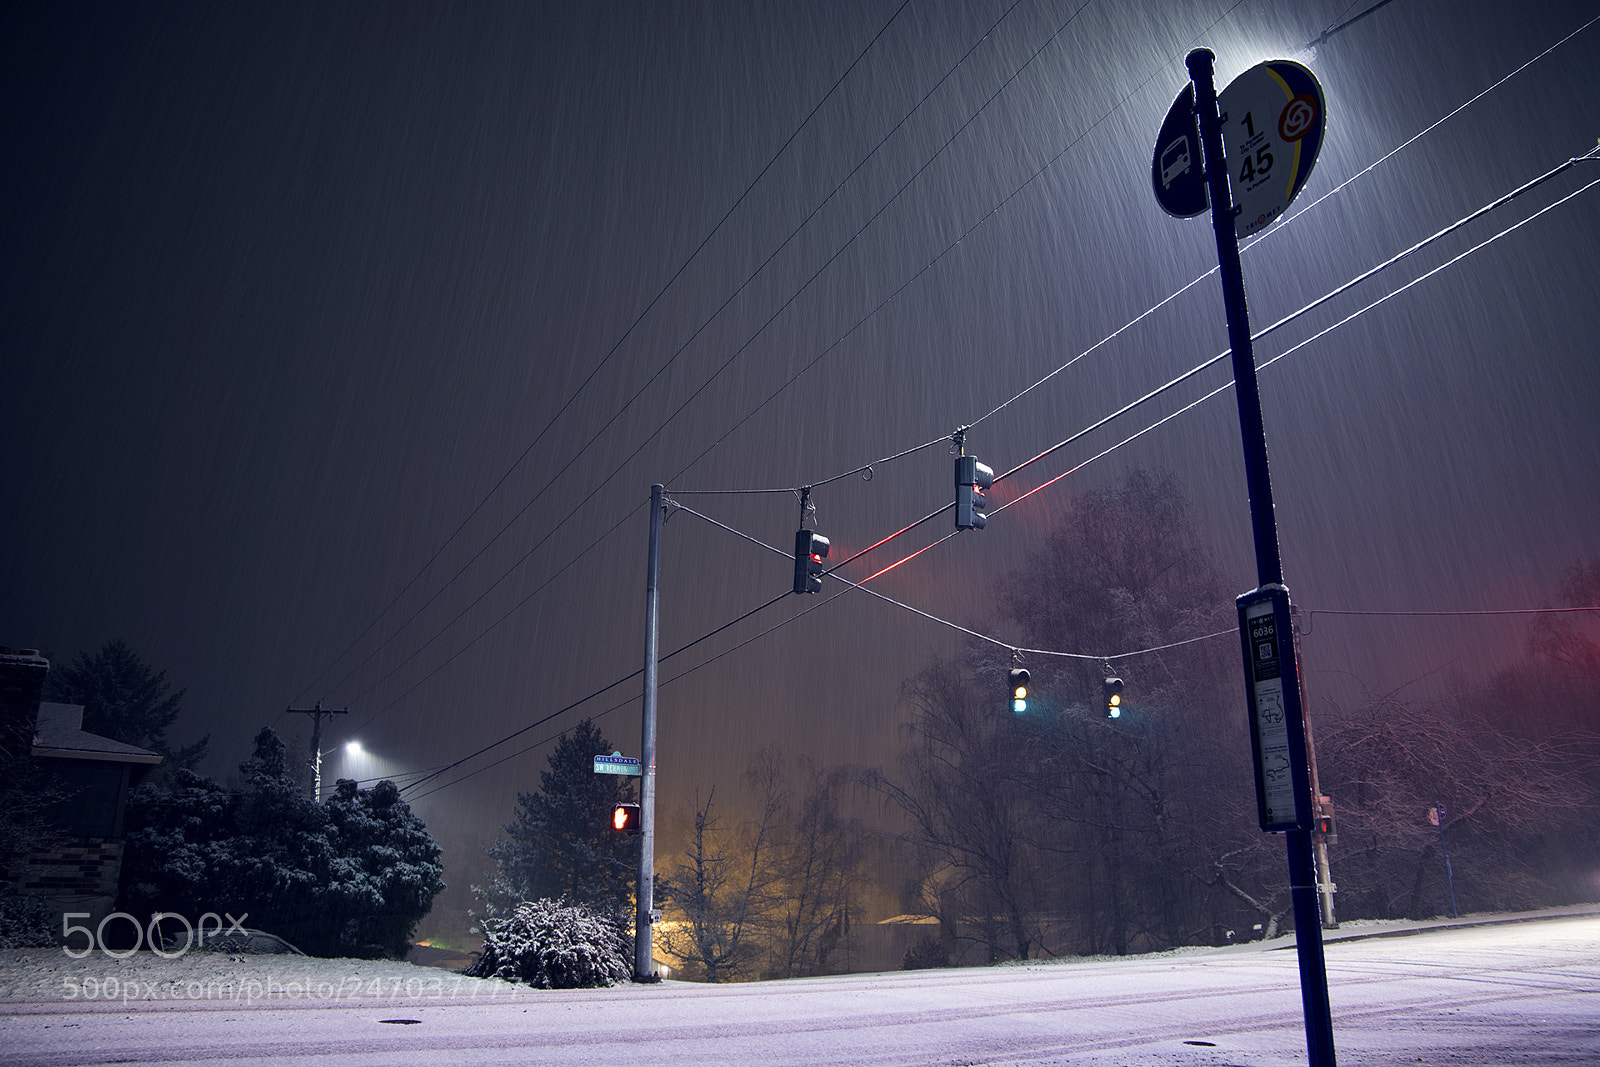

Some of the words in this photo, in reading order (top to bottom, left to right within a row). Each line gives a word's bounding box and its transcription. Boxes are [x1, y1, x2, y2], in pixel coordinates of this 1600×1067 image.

[1241, 111, 1254, 138] 1
[1239, 143, 1273, 183] 45
[1253, 625, 1274, 638] 6036
[595, 763, 604, 771] SW
